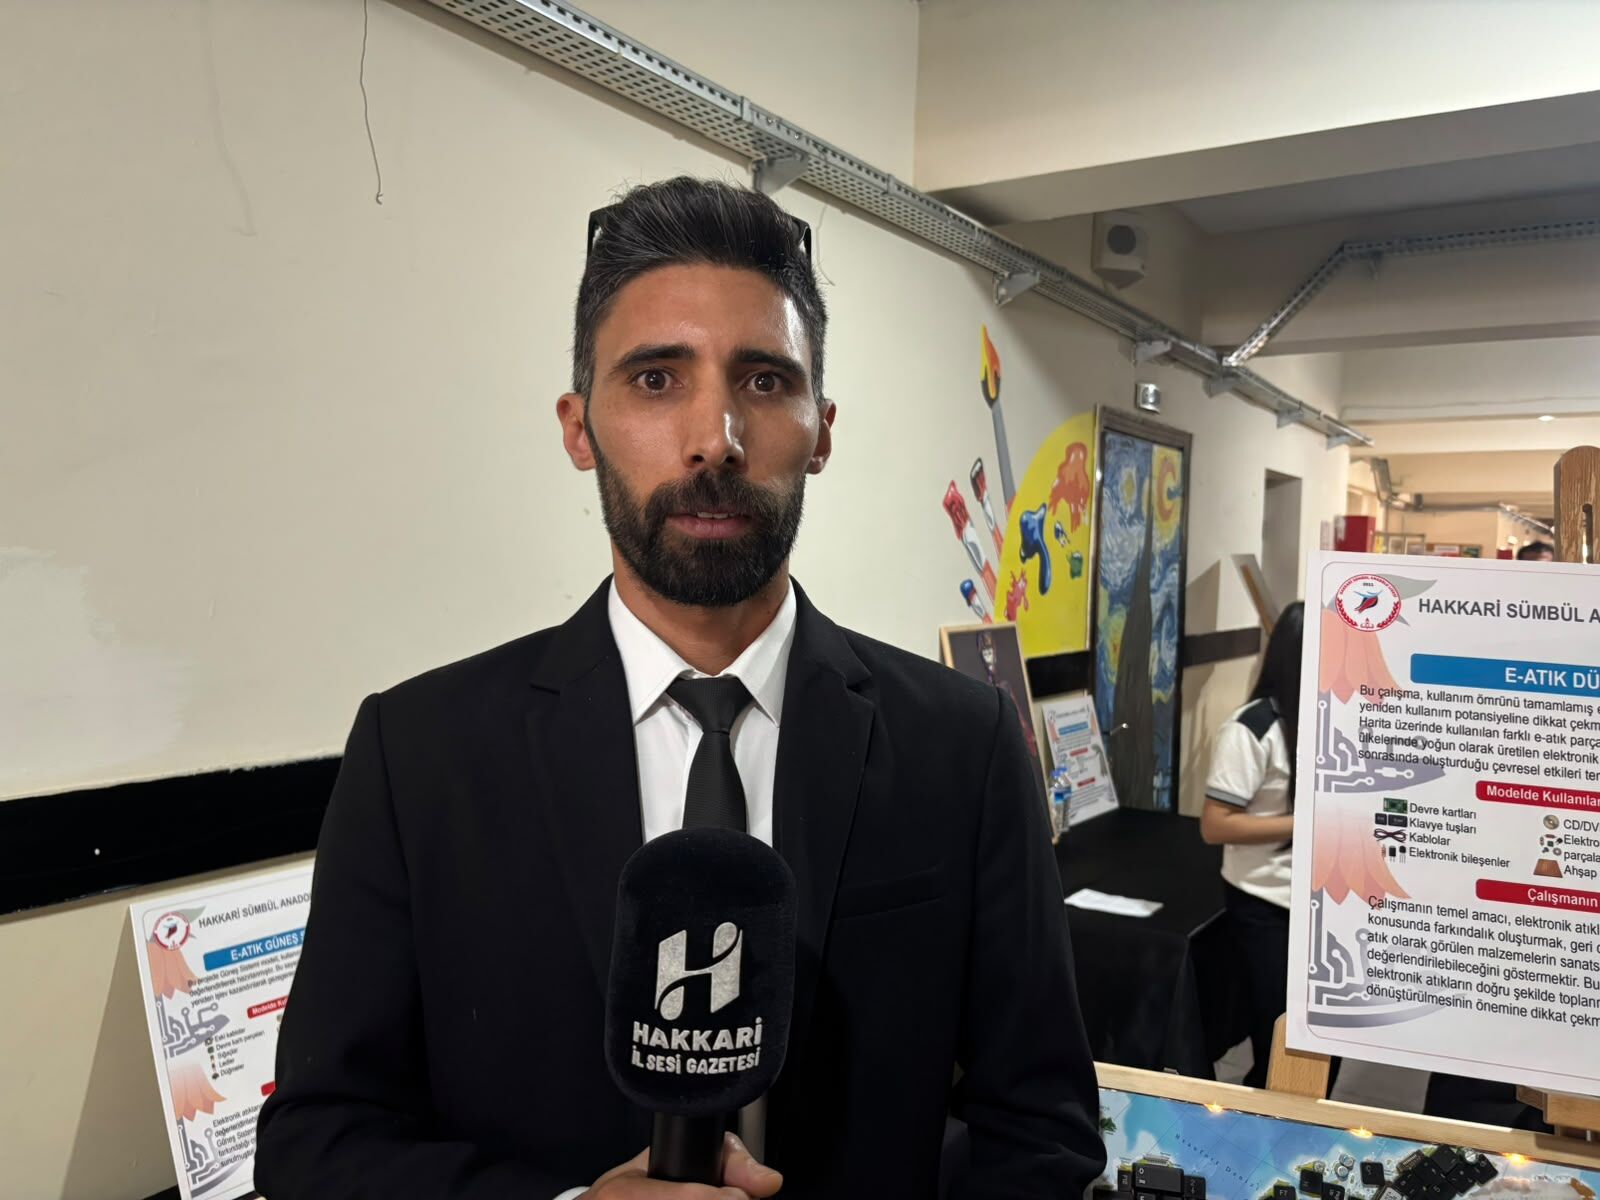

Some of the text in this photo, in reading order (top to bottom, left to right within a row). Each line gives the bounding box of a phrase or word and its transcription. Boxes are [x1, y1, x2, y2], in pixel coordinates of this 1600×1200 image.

[1419, 598, 1501, 617] HAKKARİ
[1506, 600, 1585, 623] SÜMBÜL
[1505, 667, 1600, 689] E-ATIK DÜ
[1360, 684, 1375, 696] Bu
[1378, 686, 1424, 702] çalışma,
[1427, 690, 1474, 704] kullanım
[1477, 694, 1520, 708] ömrünü
[1523, 698, 1594, 717] tamamlamış
[1359, 701, 1402, 714] yeniden
[1406, 704, 1452, 718] kullanım
[1455, 710, 1530, 725] potansiyeline
[1533, 715, 1567, 729] dikkat
[1359, 716, 1391, 729] Harita
[1395, 720, 1443, 734] üzerinde
[1446, 723, 1500, 739] kullanılan
[1503, 729, 1531, 741] farklı
[1534, 733, 1567, 745] e-atık
[1359, 731, 1599, 764] ülkelerinde yoğun olarak üretilen elektronik
[1358, 749, 1419, 764] sonrasında
[1422, 755, 1489, 773] oluşturduğu
[1492, 762, 1541, 776] çevresel
[1544, 766, 1582, 780] etkileri
[1486, 785, 1539, 800] Modelde
[1409, 802, 1477, 819] Devre kartları
[1409, 818, 1477, 835] Klavye tuşları
[1409, 832, 1451, 846] Kablolar
[1563, 819, 1600, 833] CD/DV
[1564, 834, 1600, 848] Elektro
[1409, 847, 1510, 868] Elektronik bileşenler
[1563, 865, 1597, 880] Ahşap
[1527, 888, 1598, 908] Çalışmanın
[198, 908, 241, 928] HAKKARİ
[242, 900, 279, 918] SÜMBÜL
[1368, 895, 1433, 915] Çalışmanın
[1436, 904, 1468, 919] temel
[1472, 911, 1511, 926] amacı,
[1515, 915, 1572, 932] elektronik
[230, 942, 263, 961] E-ATIK
[265, 932, 299, 951] GÜNEŞ
[1368, 913, 1431, 932] konusunda
[1434, 921, 1495, 941] farkındalık
[1498, 930, 1567, 951] oluşturmak,
[1570, 940, 1593, 954] geri
[1367, 932, 1600, 972] atık olarak görülen malzemelerin sanats
[1367, 948, 1600, 990] değerlendirilebileceğini göstermektir. Bu
[1366, 966, 1422, 984] elektronik
[1425, 975, 1473, 991] atıkların
[1476, 981, 1510, 998] doğru
[1513, 987, 1556, 1003] şekilde
[1366, 983, 1473, 1009] dönüştürülmesinin
[1475, 998, 1528, 1018] önemine
[1530, 1006, 1567, 1023] dikkat
[632, 1016, 763, 1052] HAKKARİ
[631, 1045, 761, 1075] İL SESİ GAZETESİ
